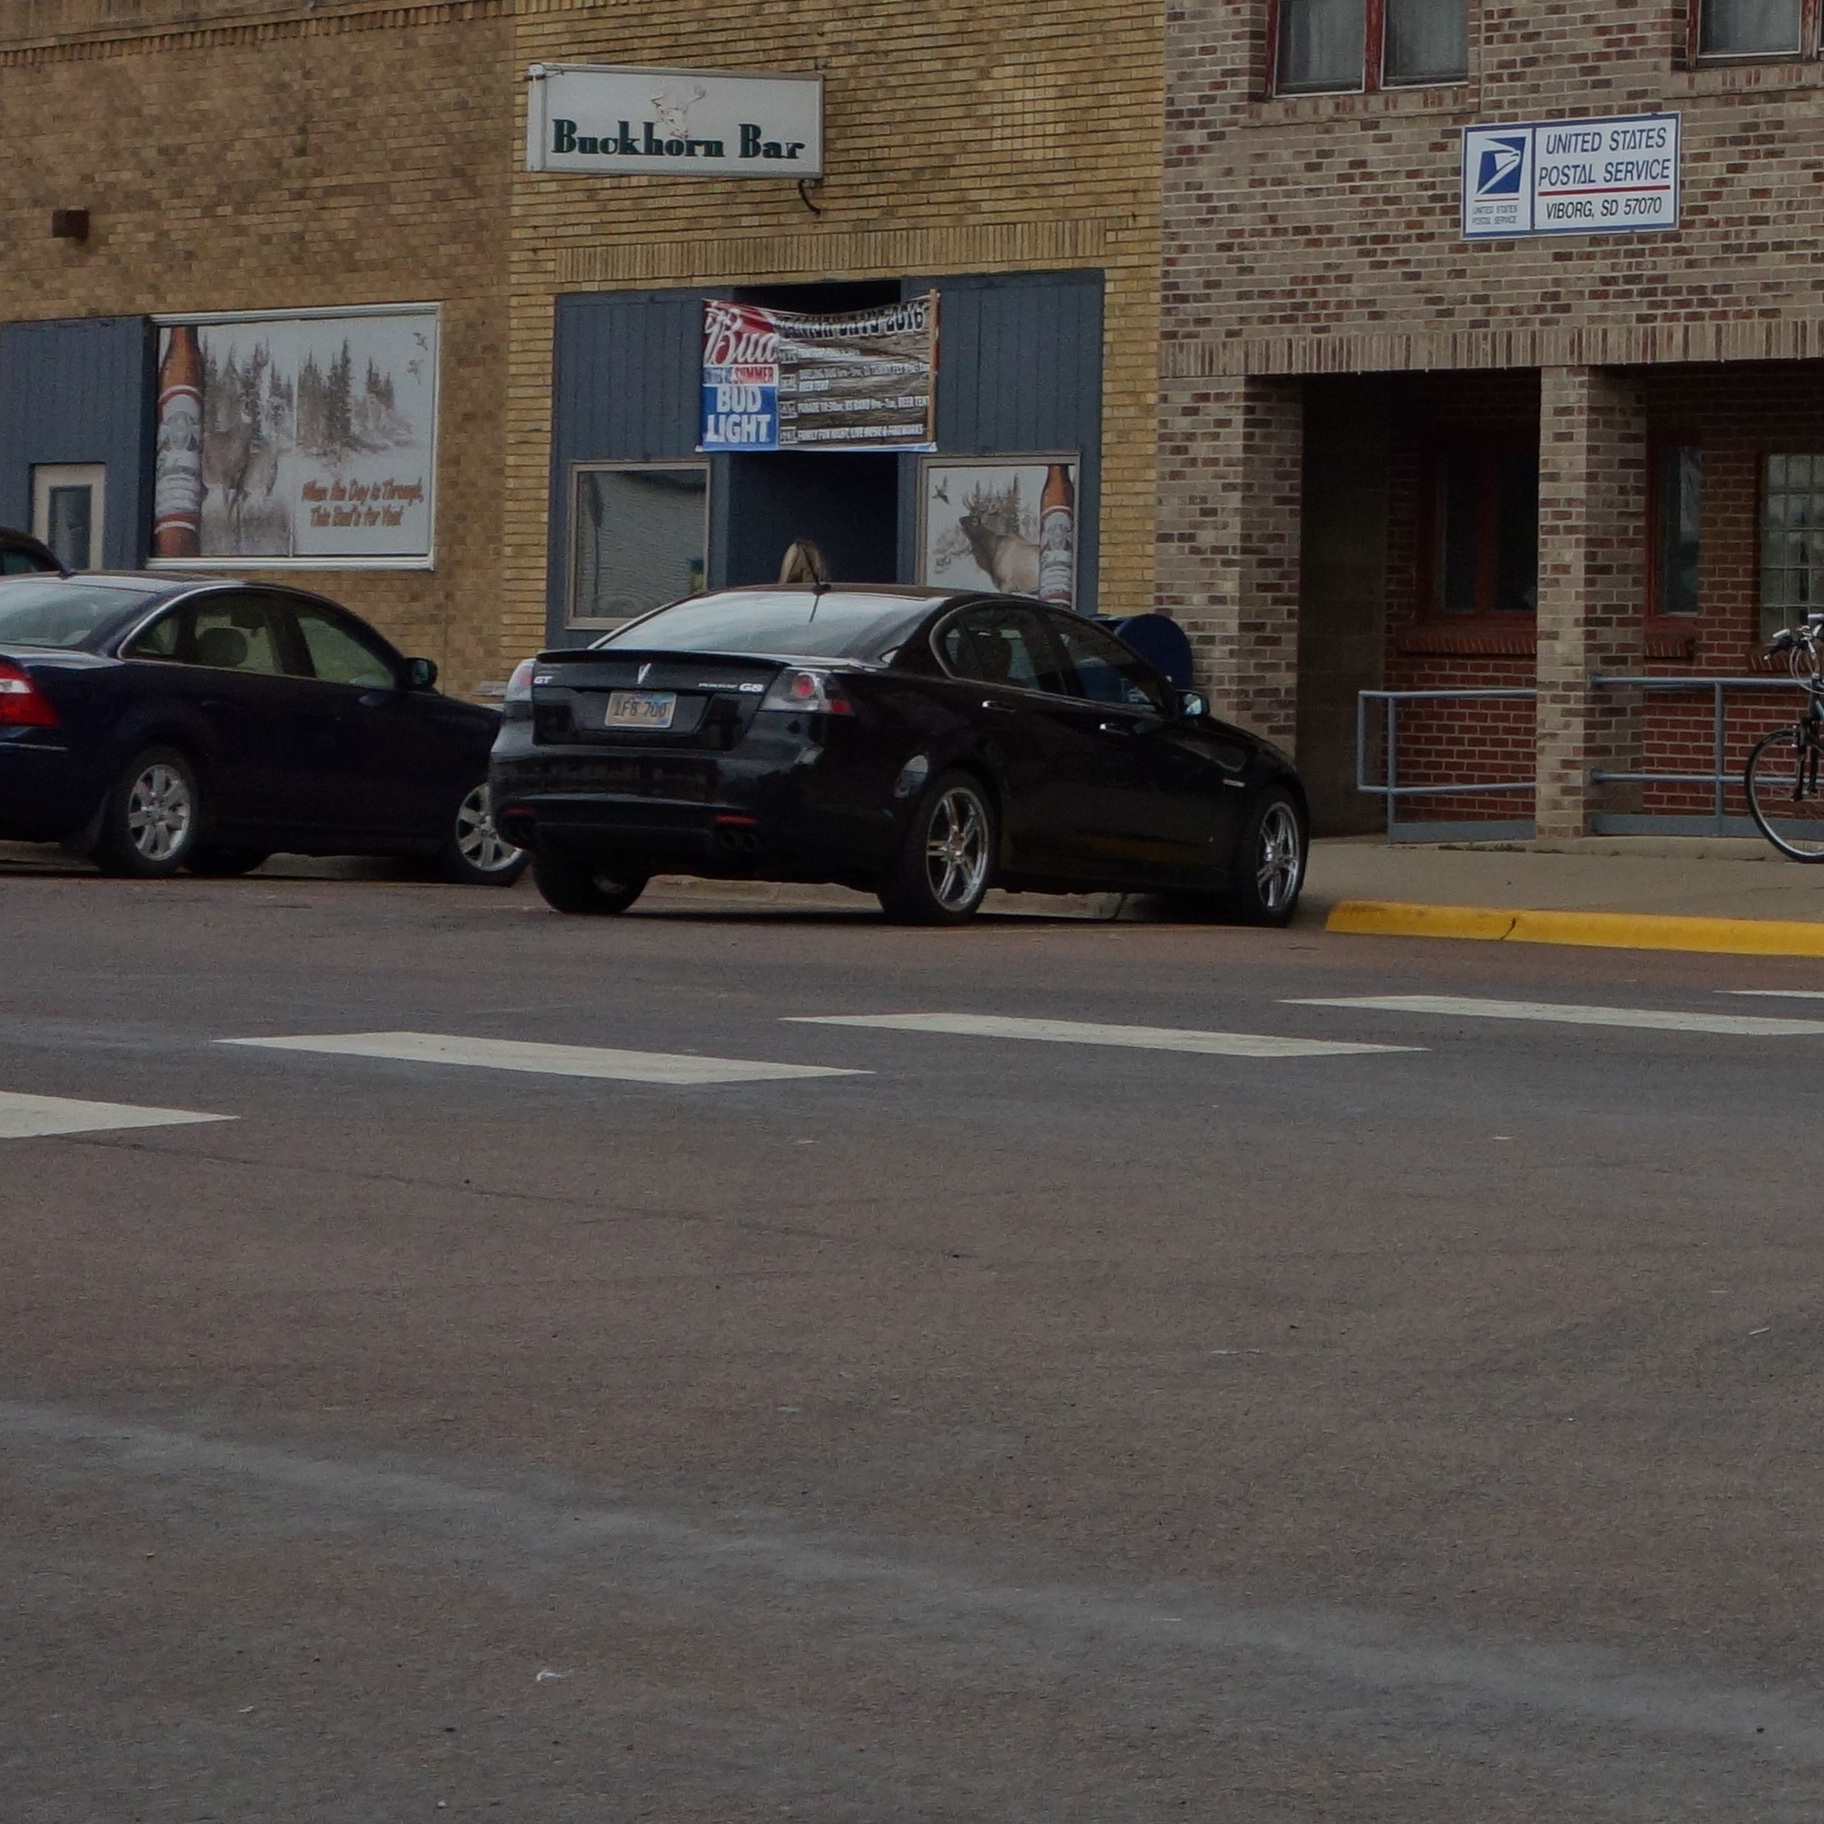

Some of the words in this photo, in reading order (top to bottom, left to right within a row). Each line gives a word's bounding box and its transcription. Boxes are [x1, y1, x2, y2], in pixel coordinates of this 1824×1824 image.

[552, 118, 726, 157] Buckhorn
[738, 122, 806, 160] Bar
[1545, 131, 1602, 155] UNITED
[1609, 126, 1667, 152] STATES
[1538, 163, 1597, 187] POSTAL
[1603, 158, 1671, 183] SERVICE
[1472, 206, 1494, 215] UNITED
[1496, 205, 1518, 214] STATES
[1472, 217, 1492, 226] POSTAL
[1494, 216, 1517, 225] SERVICE
[1546, 199, 1595, 221] VIBORG,
[1600, 198, 1619, 217] SD
[1623, 196, 1662, 216] 57070
[716, 386, 762, 413] BUD
[705, 414, 771, 444] LIGHT
[533, 675, 552, 684] GT
[739, 682, 765, 693] G8
